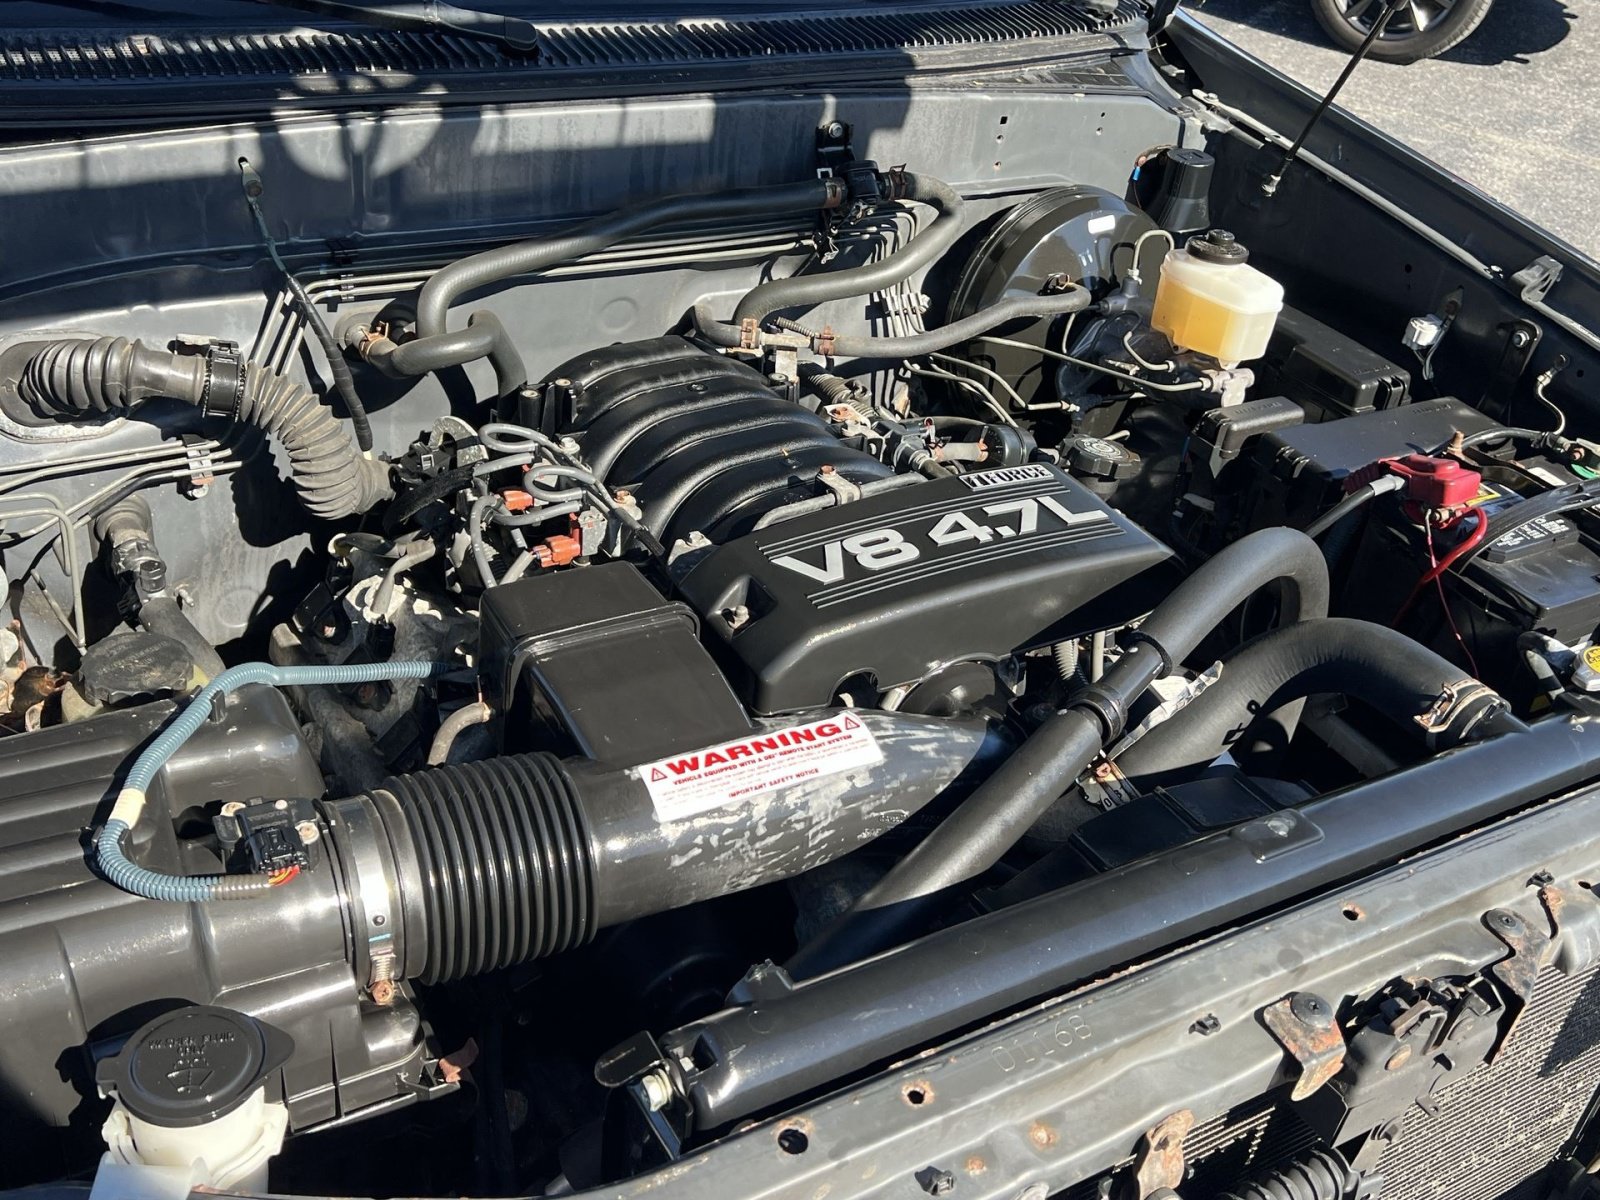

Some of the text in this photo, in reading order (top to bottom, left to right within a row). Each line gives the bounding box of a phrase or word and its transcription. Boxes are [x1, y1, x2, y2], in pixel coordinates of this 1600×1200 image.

[771, 496, 1110, 585] V8 4.7L
[665, 723, 842, 775] WARNING
[673, 774, 702, 785] VEHICLE
[704, 764, 737, 777] EQUIPPED
[739, 758, 756, 768] WITH
[779, 747, 805, 757] REMOTE
[806, 741, 826, 751] START
[828, 734, 853, 745] SYSTEM
[728, 783, 767, 798] IMPORTANT
[769, 775, 793, 787] SAFETY
[796, 767, 819, 779] NOTICE
